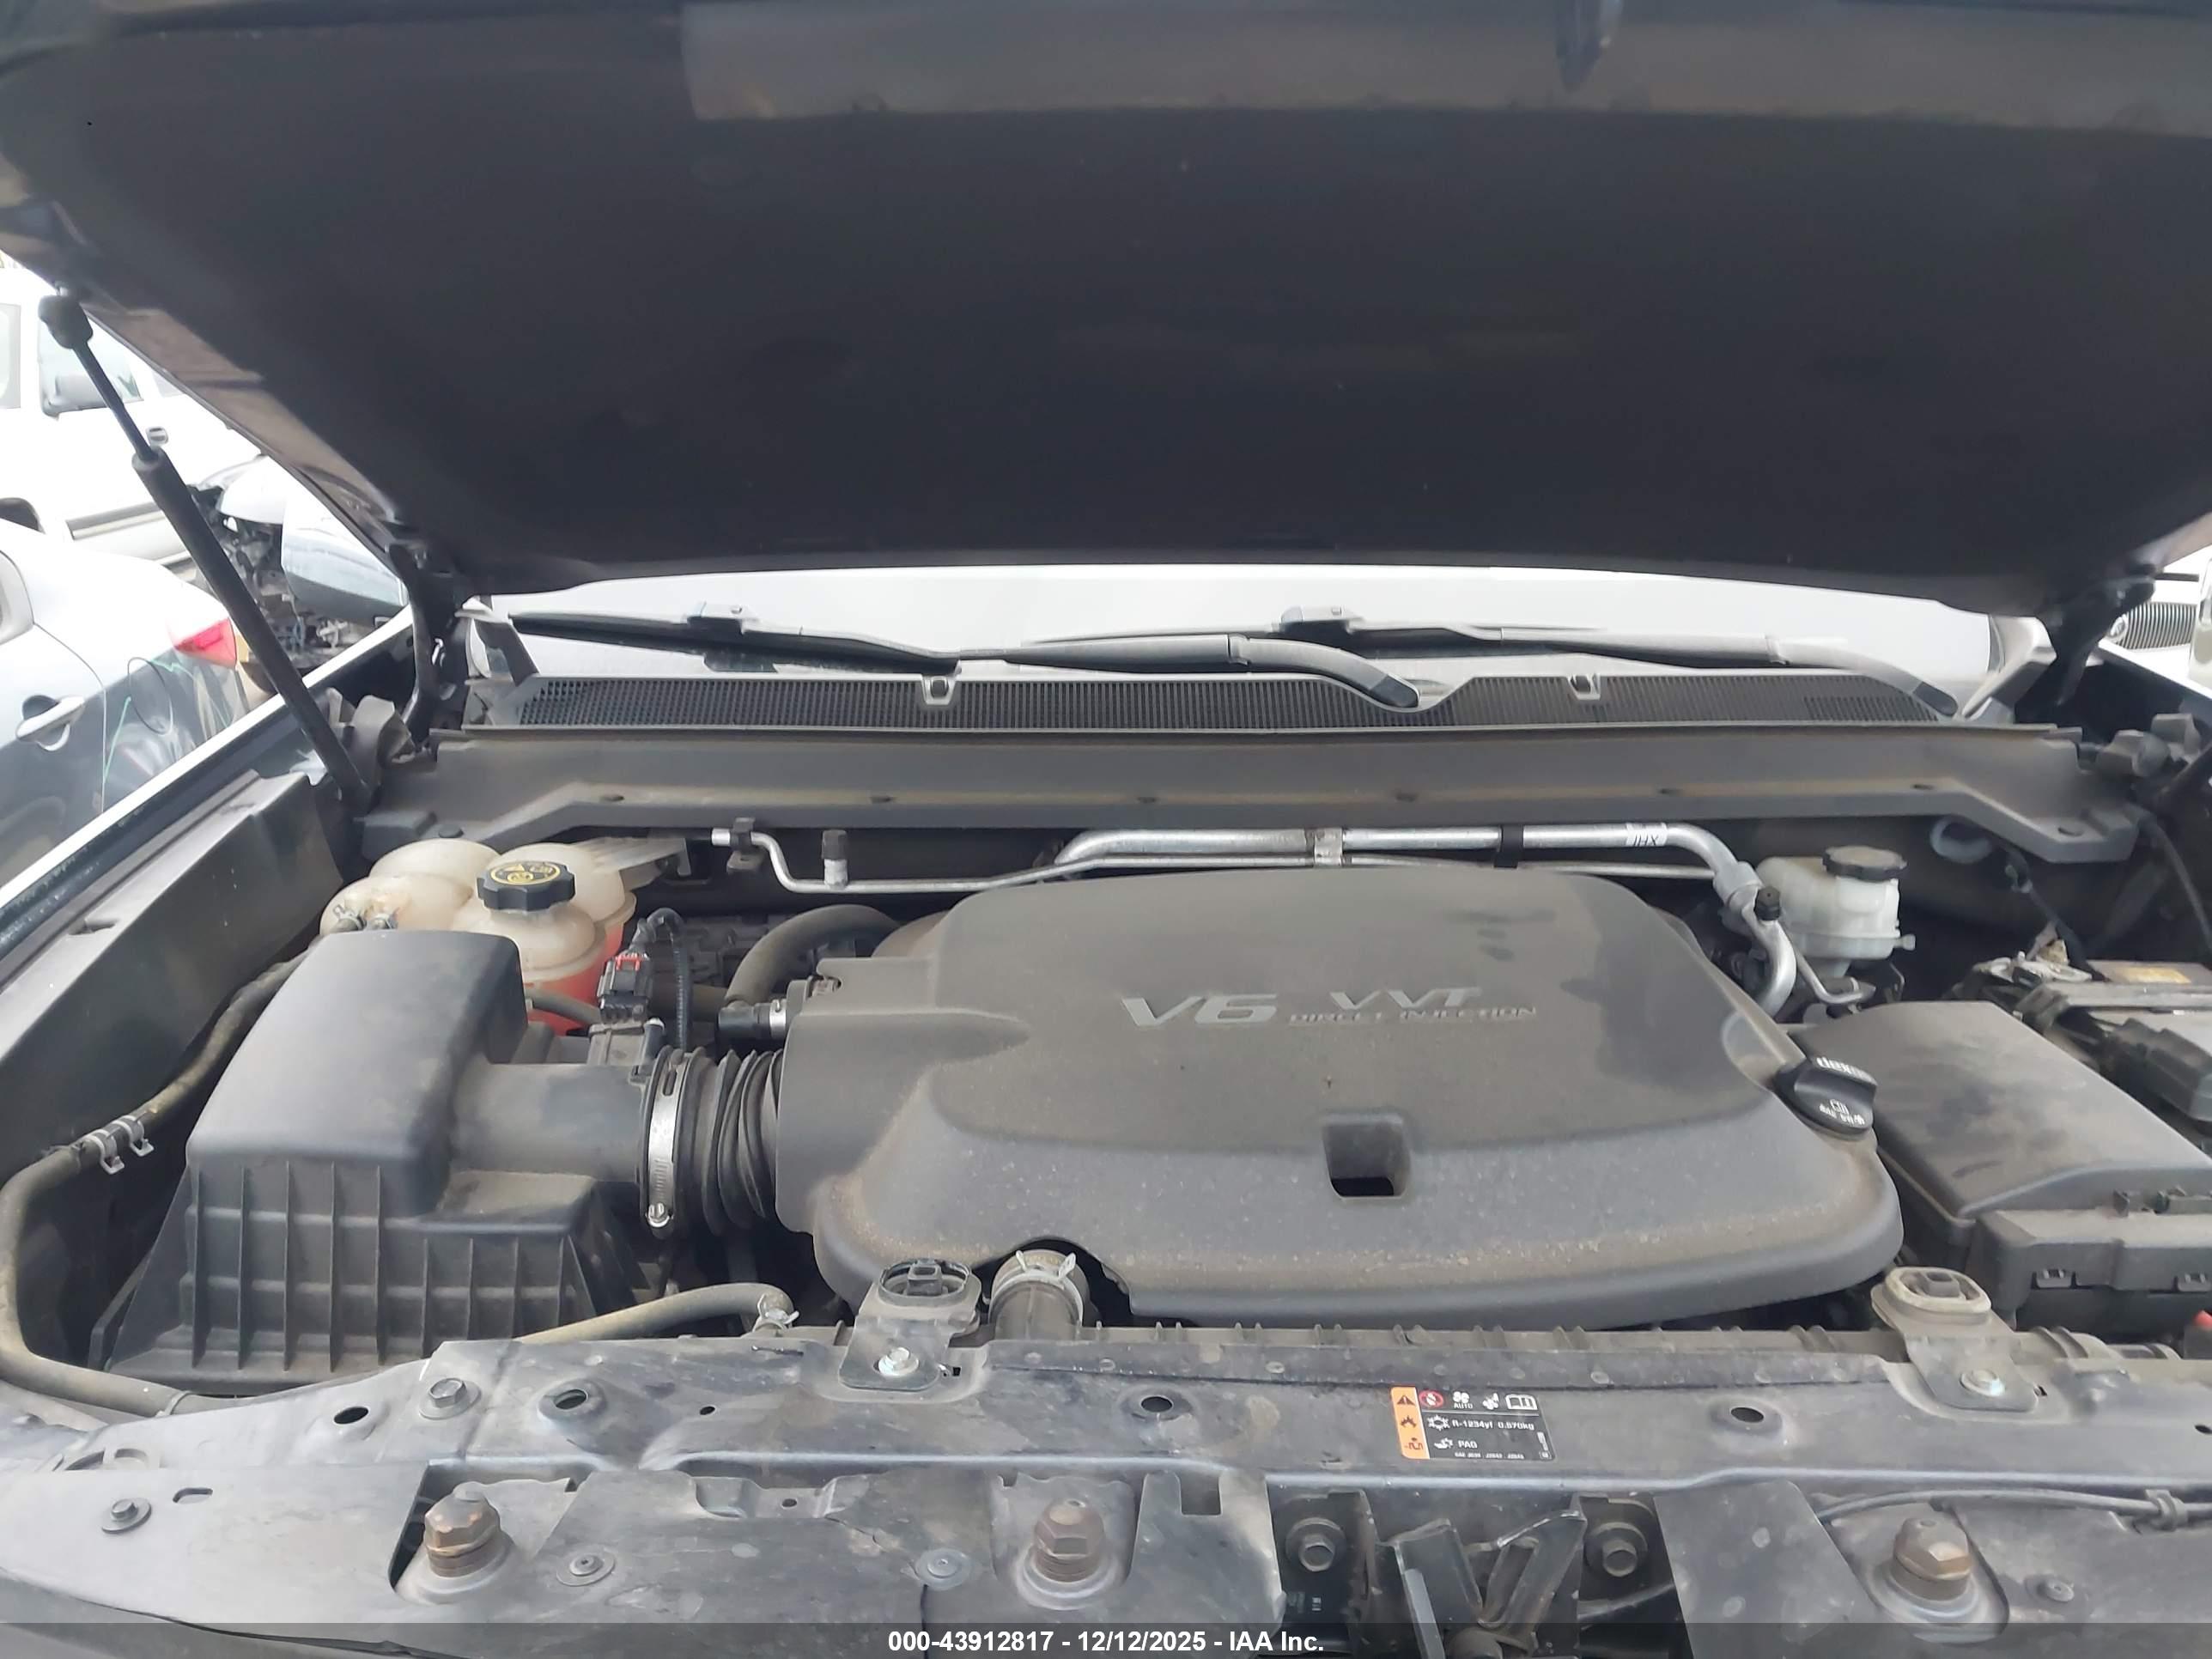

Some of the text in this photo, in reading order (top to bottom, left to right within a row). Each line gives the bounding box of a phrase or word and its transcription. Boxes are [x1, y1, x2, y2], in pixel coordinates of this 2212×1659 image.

[1121, 987, 1482, 1027] V6 VVT
[1451, 1419, 1493, 1430] R-1234yf
